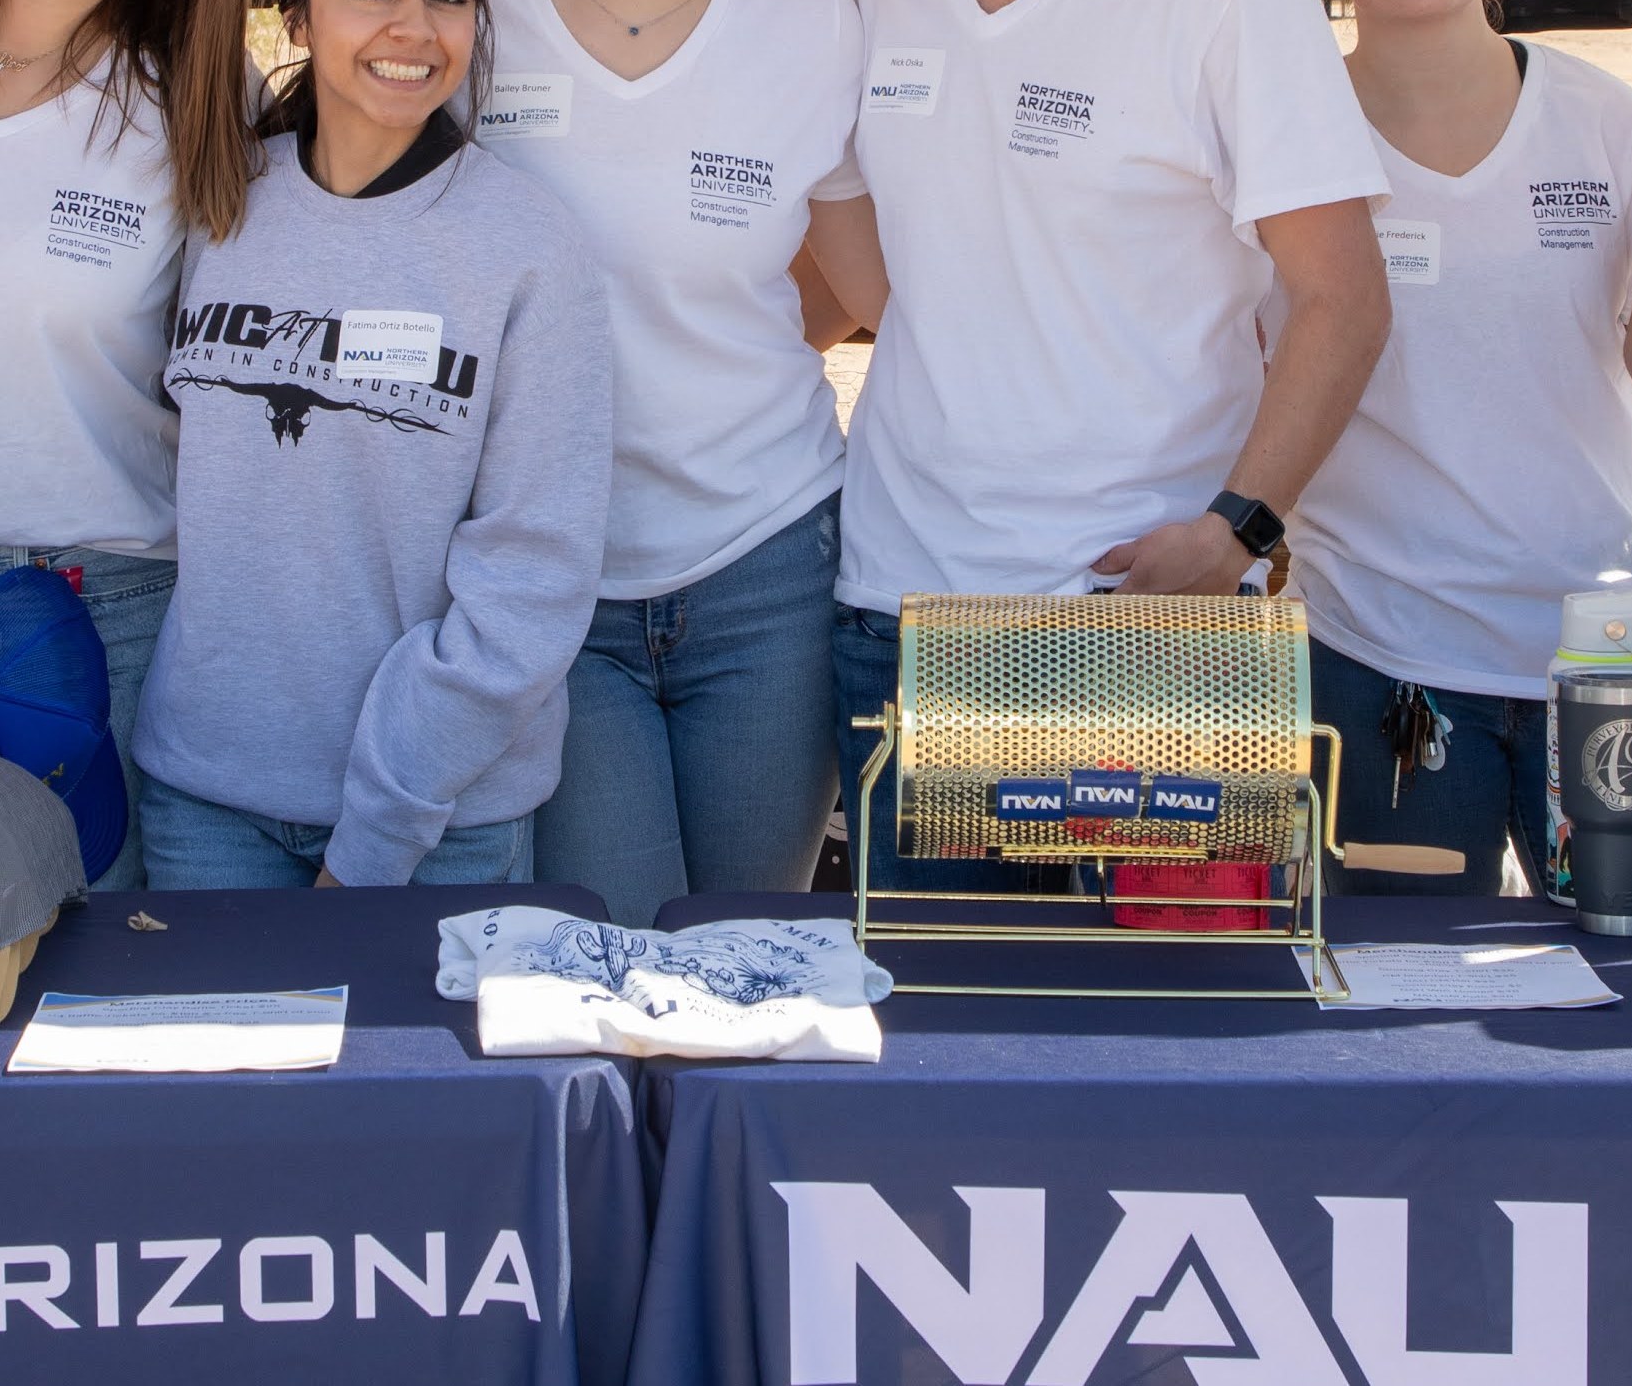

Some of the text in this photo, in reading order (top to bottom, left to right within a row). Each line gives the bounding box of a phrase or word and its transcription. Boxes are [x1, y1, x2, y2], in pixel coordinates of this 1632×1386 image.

[494, 84, 520, 93] Bailey
[871, 86, 897, 97] NAU
[1020, 83, 1094, 105] NORTHERN
[1017, 96, 1091, 120] ARIZONA
[481, 113, 517, 125] NAU
[1015, 109, 1090, 132] UNIVERSITY
[1011, 130, 1058, 145] Construction
[1008, 141, 1059, 159] Management
[691, 150, 773, 172] NORTHERN
[691, 163, 772, 188] ARIZONA
[691, 177, 772, 201] UNIVERSITY
[1529, 181, 1608, 193] NORTHERN
[56, 189, 146, 215] NORTHERN
[691, 198, 748, 216] Construction
[1532, 193, 1610, 207] ARIZONA
[52, 201, 142, 231] ARIZONA
[690, 211, 750, 229] Management
[1533, 208, 1611, 218] UNIVERSITY
[50, 214, 141, 244] UNIVERSITY
[1387, 231, 1426, 240] Frederick
[1538, 228, 1590, 237] Construction
[48, 233, 110, 256] Construction
[1541, 240, 1593, 250] Management
[46, 246, 112, 270] Management
[176, 303, 272, 350] WIC
[347, 322, 377, 330] Fatima
[379, 322, 400, 331] Ortiz
[344, 350, 383, 361] NAU
[231, 351, 468, 418] IN CONSRUCTION
[1002, 795, 1061, 810] NAU
[1075, 786, 1134, 803] NAU
[1156, 791, 1215, 812] NAU
[769, 1181, 1589, 1385] NAU
